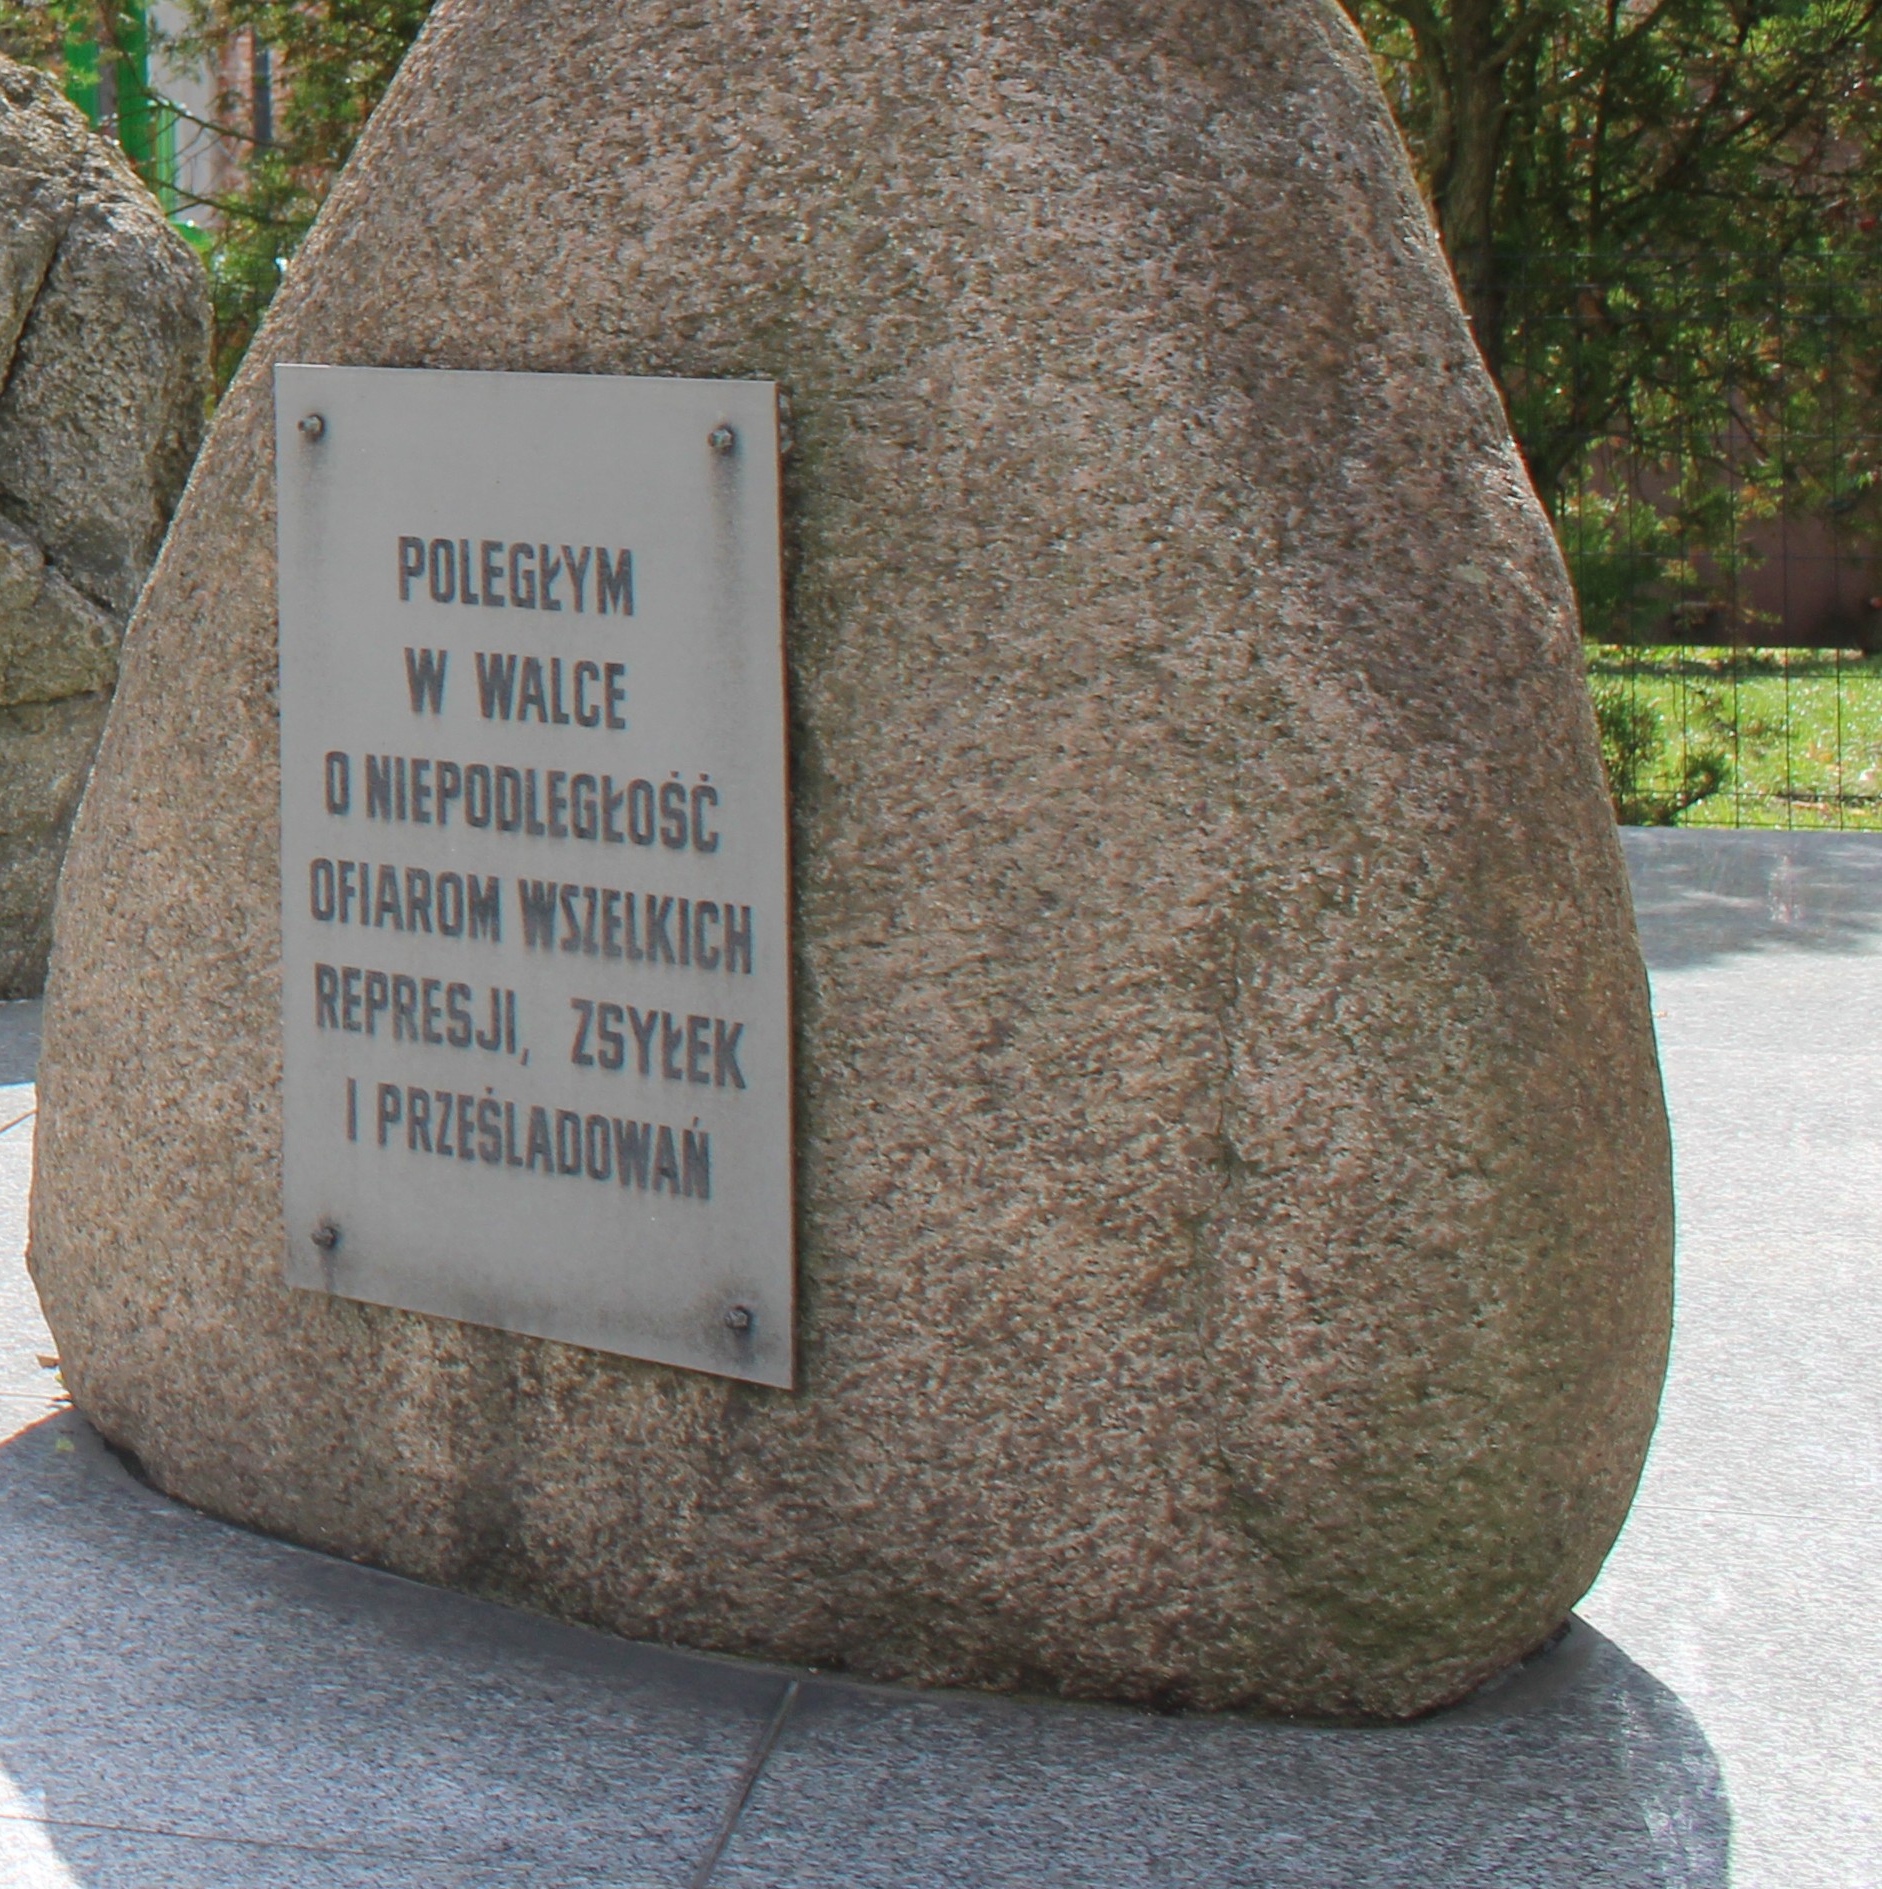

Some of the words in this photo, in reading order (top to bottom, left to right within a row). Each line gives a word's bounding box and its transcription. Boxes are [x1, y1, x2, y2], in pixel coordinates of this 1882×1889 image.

[398, 535, 635, 617] POLEGŁYM
[404, 646, 448, 716] W
[474, 651, 627, 731] WALCE
[324, 750, 351, 817] O
[365, 753, 720, 855] NIEPODLEGŁOŚĆ
[309, 857, 501, 944] OFIAROM
[517, 878, 753, 976] WSZELKICH
[314, 962, 530, 1067] REPRESJI,
[570, 997, 747, 1091] ZSYŁEK
[346, 1077, 358, 1143] I
[377, 1082, 712, 1202] PRZEŚLADOWAŃ
